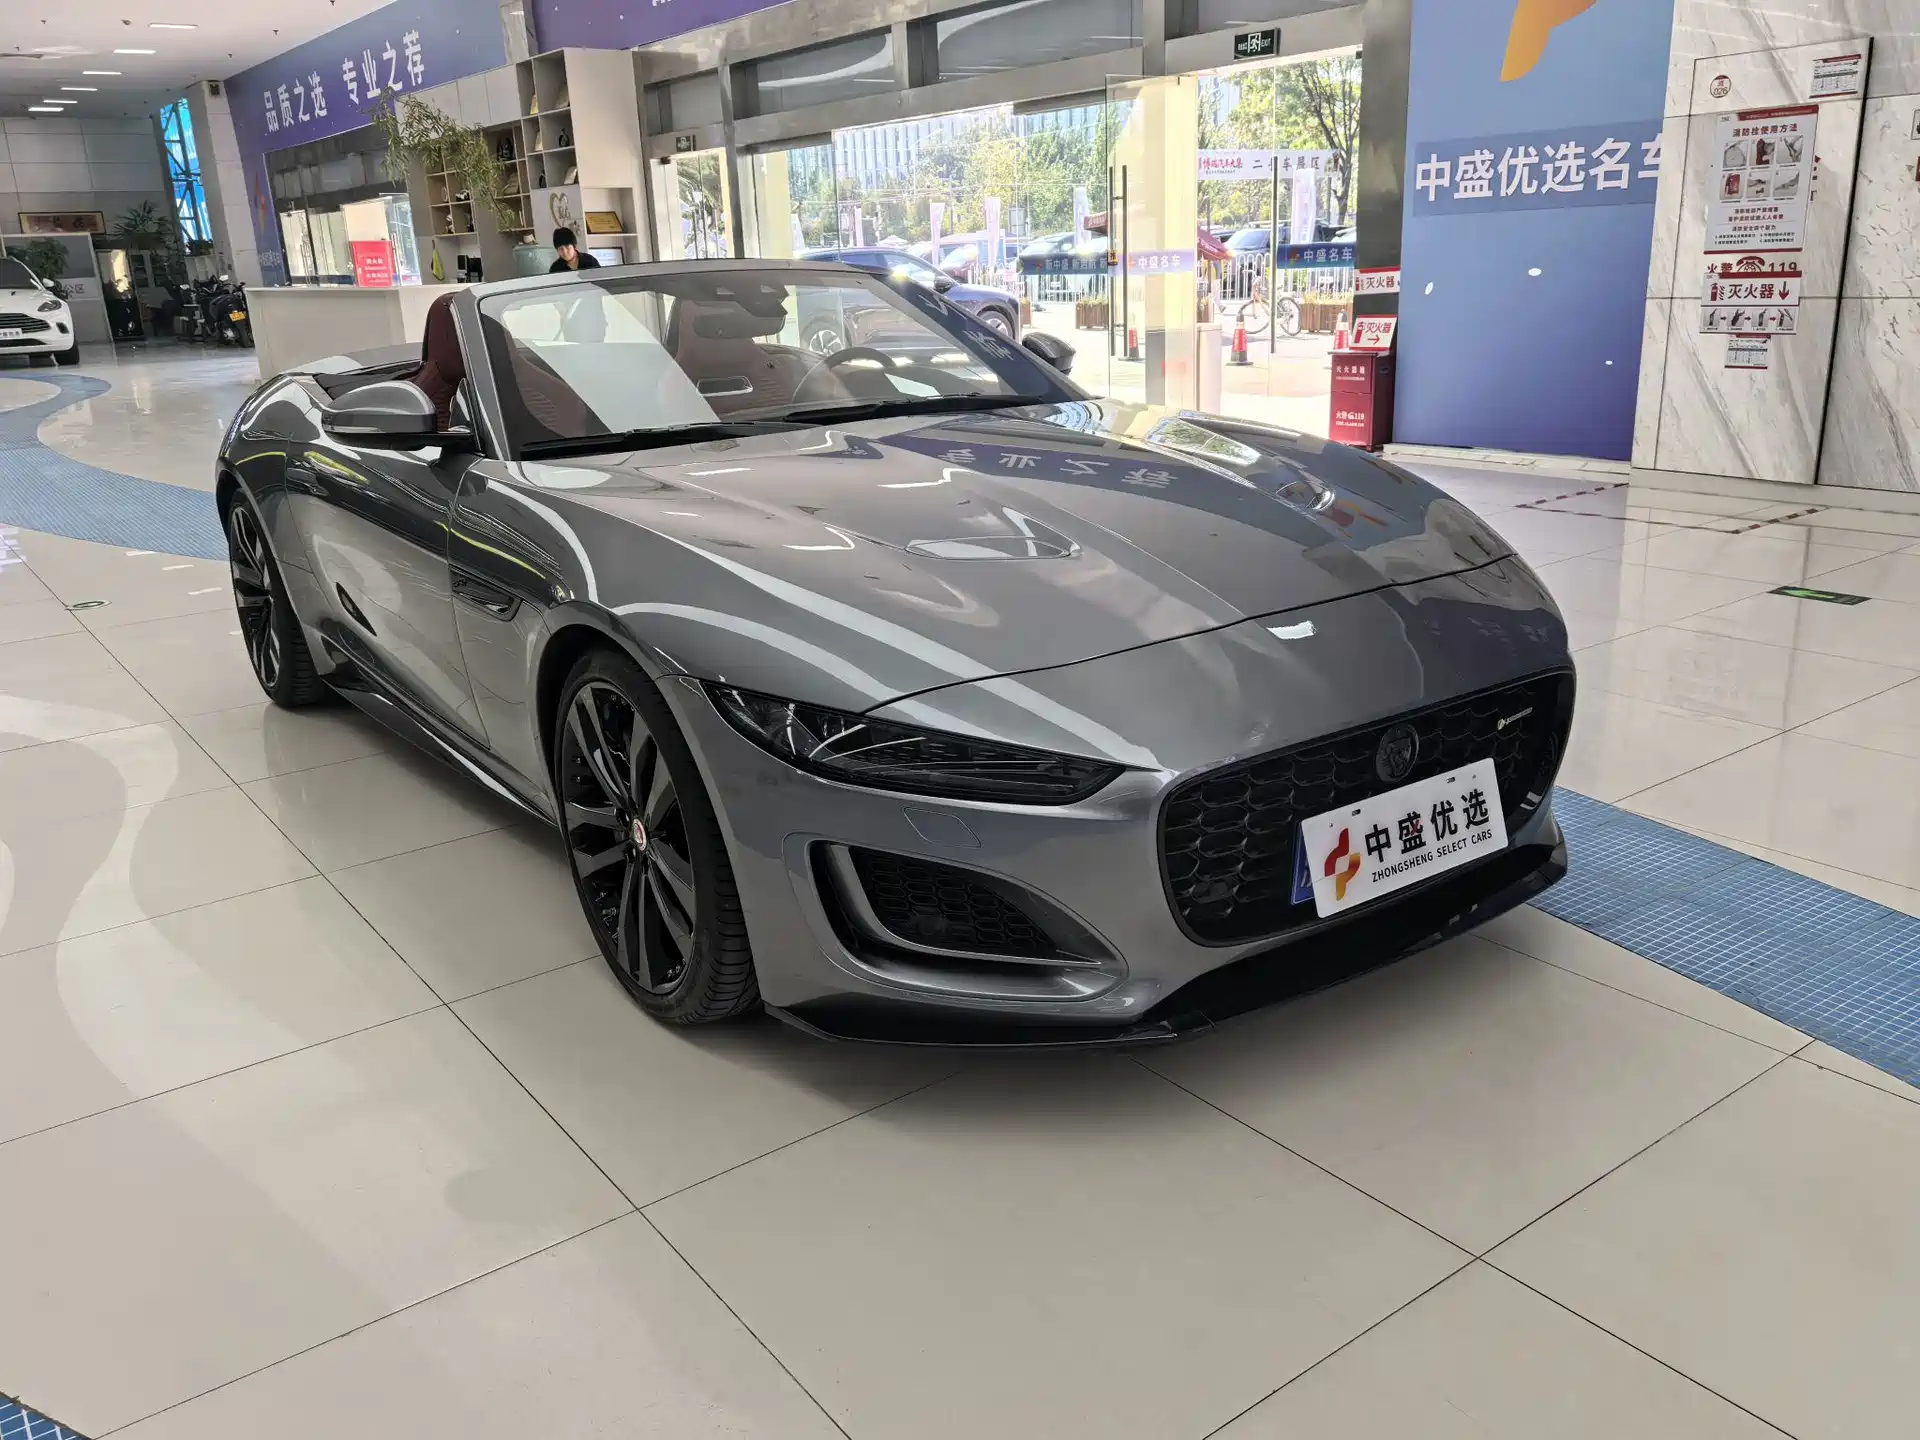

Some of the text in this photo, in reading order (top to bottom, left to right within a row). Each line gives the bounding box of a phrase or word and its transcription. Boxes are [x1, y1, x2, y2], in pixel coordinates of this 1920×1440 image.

[264, 29, 425, 133] 品质之选 专业之荐
[1303, 247, 1353, 262] 中盛名车
[1768, 262, 1798, 273] 119
[1366, 276, 1395, 288] 灭火器
[1727, 283, 1775, 299] 灭火器
[1366, 322, 1392, 333] 灭火器
[1364, 788, 1490, 863] 中盛优选
[1371, 828, 1493, 882] ZHONGSHENG SELECT CARS
